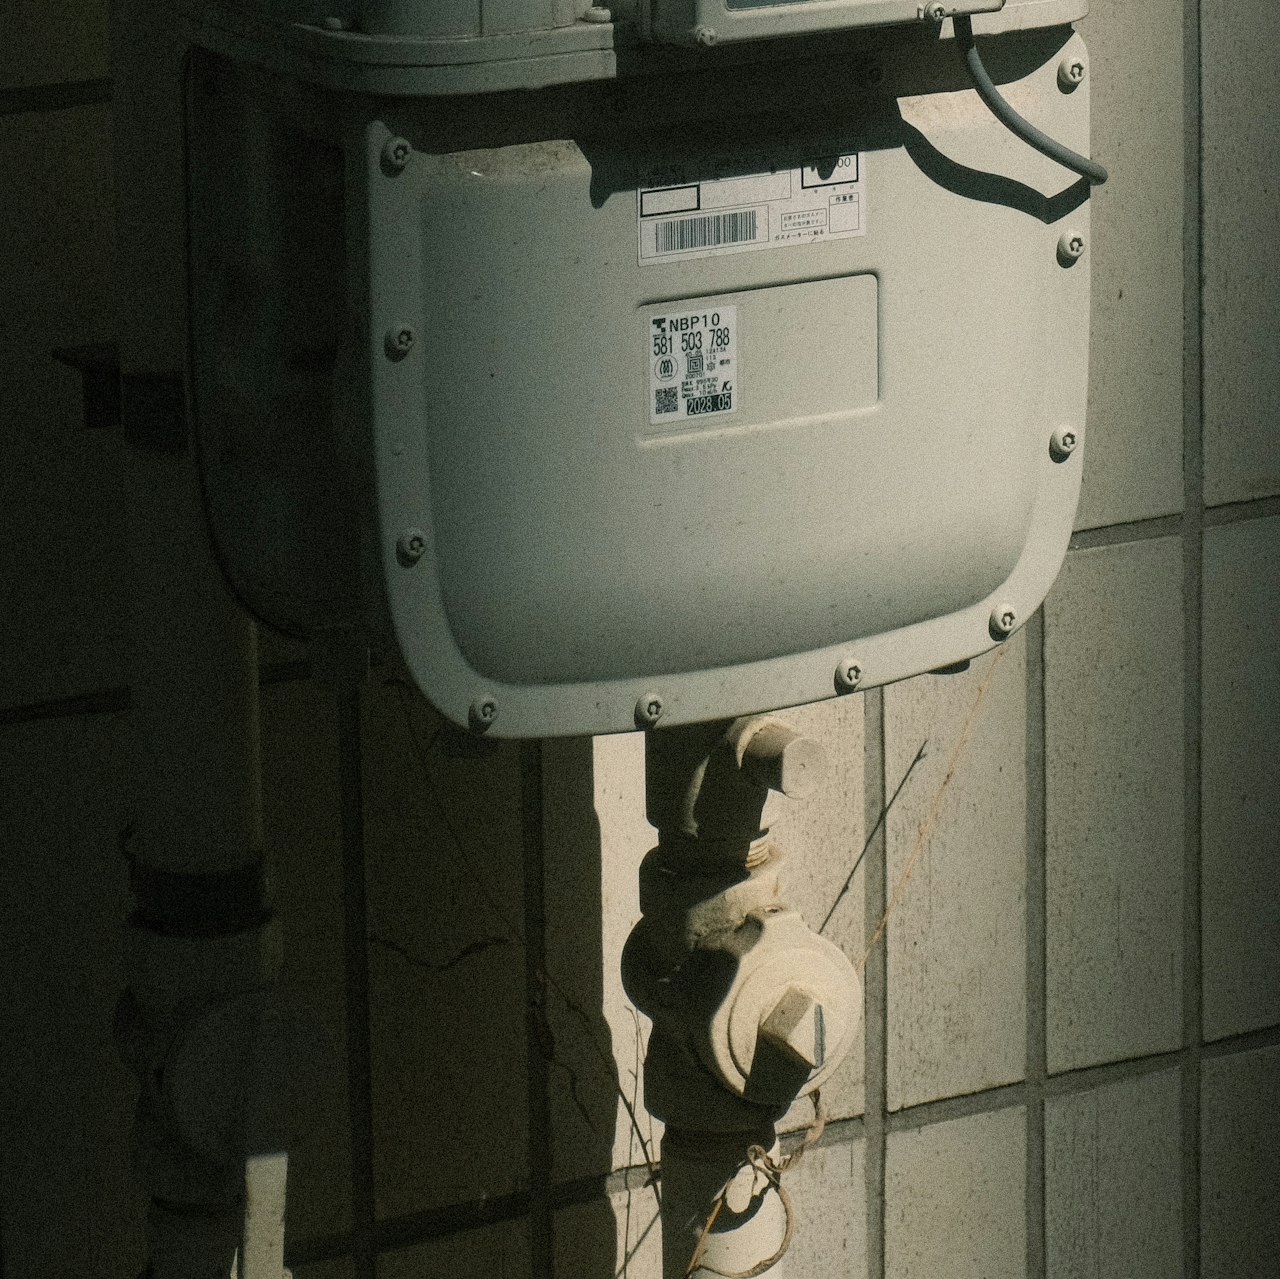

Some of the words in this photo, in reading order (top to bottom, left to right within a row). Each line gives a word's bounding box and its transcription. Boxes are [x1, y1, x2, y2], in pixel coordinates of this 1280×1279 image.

[669, 312, 720, 333] NBP10
[653, 335, 673, 355] 581
[681, 330, 702, 352] 503
[709, 327, 730, 349] 788
[688, 395, 731, 414] 2028.05
